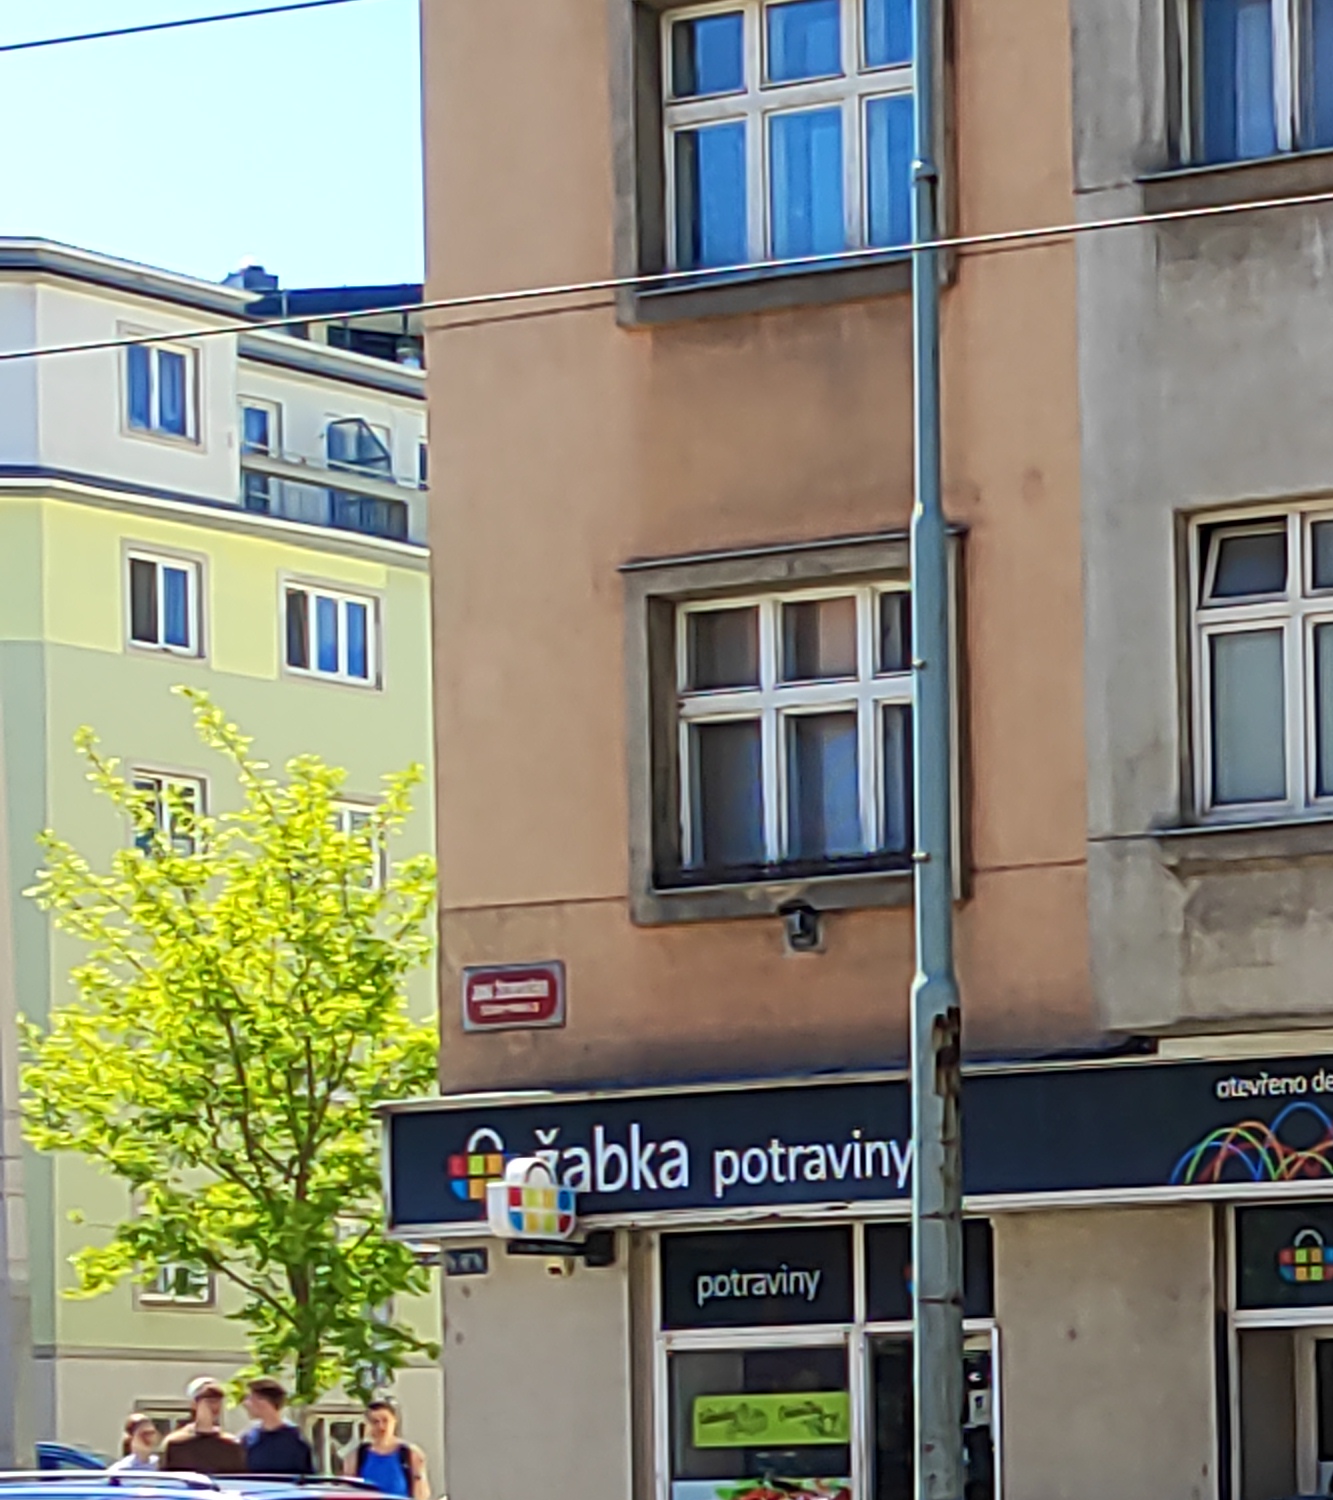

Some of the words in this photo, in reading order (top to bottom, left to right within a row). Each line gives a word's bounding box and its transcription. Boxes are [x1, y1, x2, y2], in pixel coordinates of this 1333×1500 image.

[1215, 1071, 1308, 1098] otevřeno
[534, 1122, 690, 1194] žabka
[713, 1127, 914, 1199] potraviny
[697, 1262, 822, 1306] potraviny
